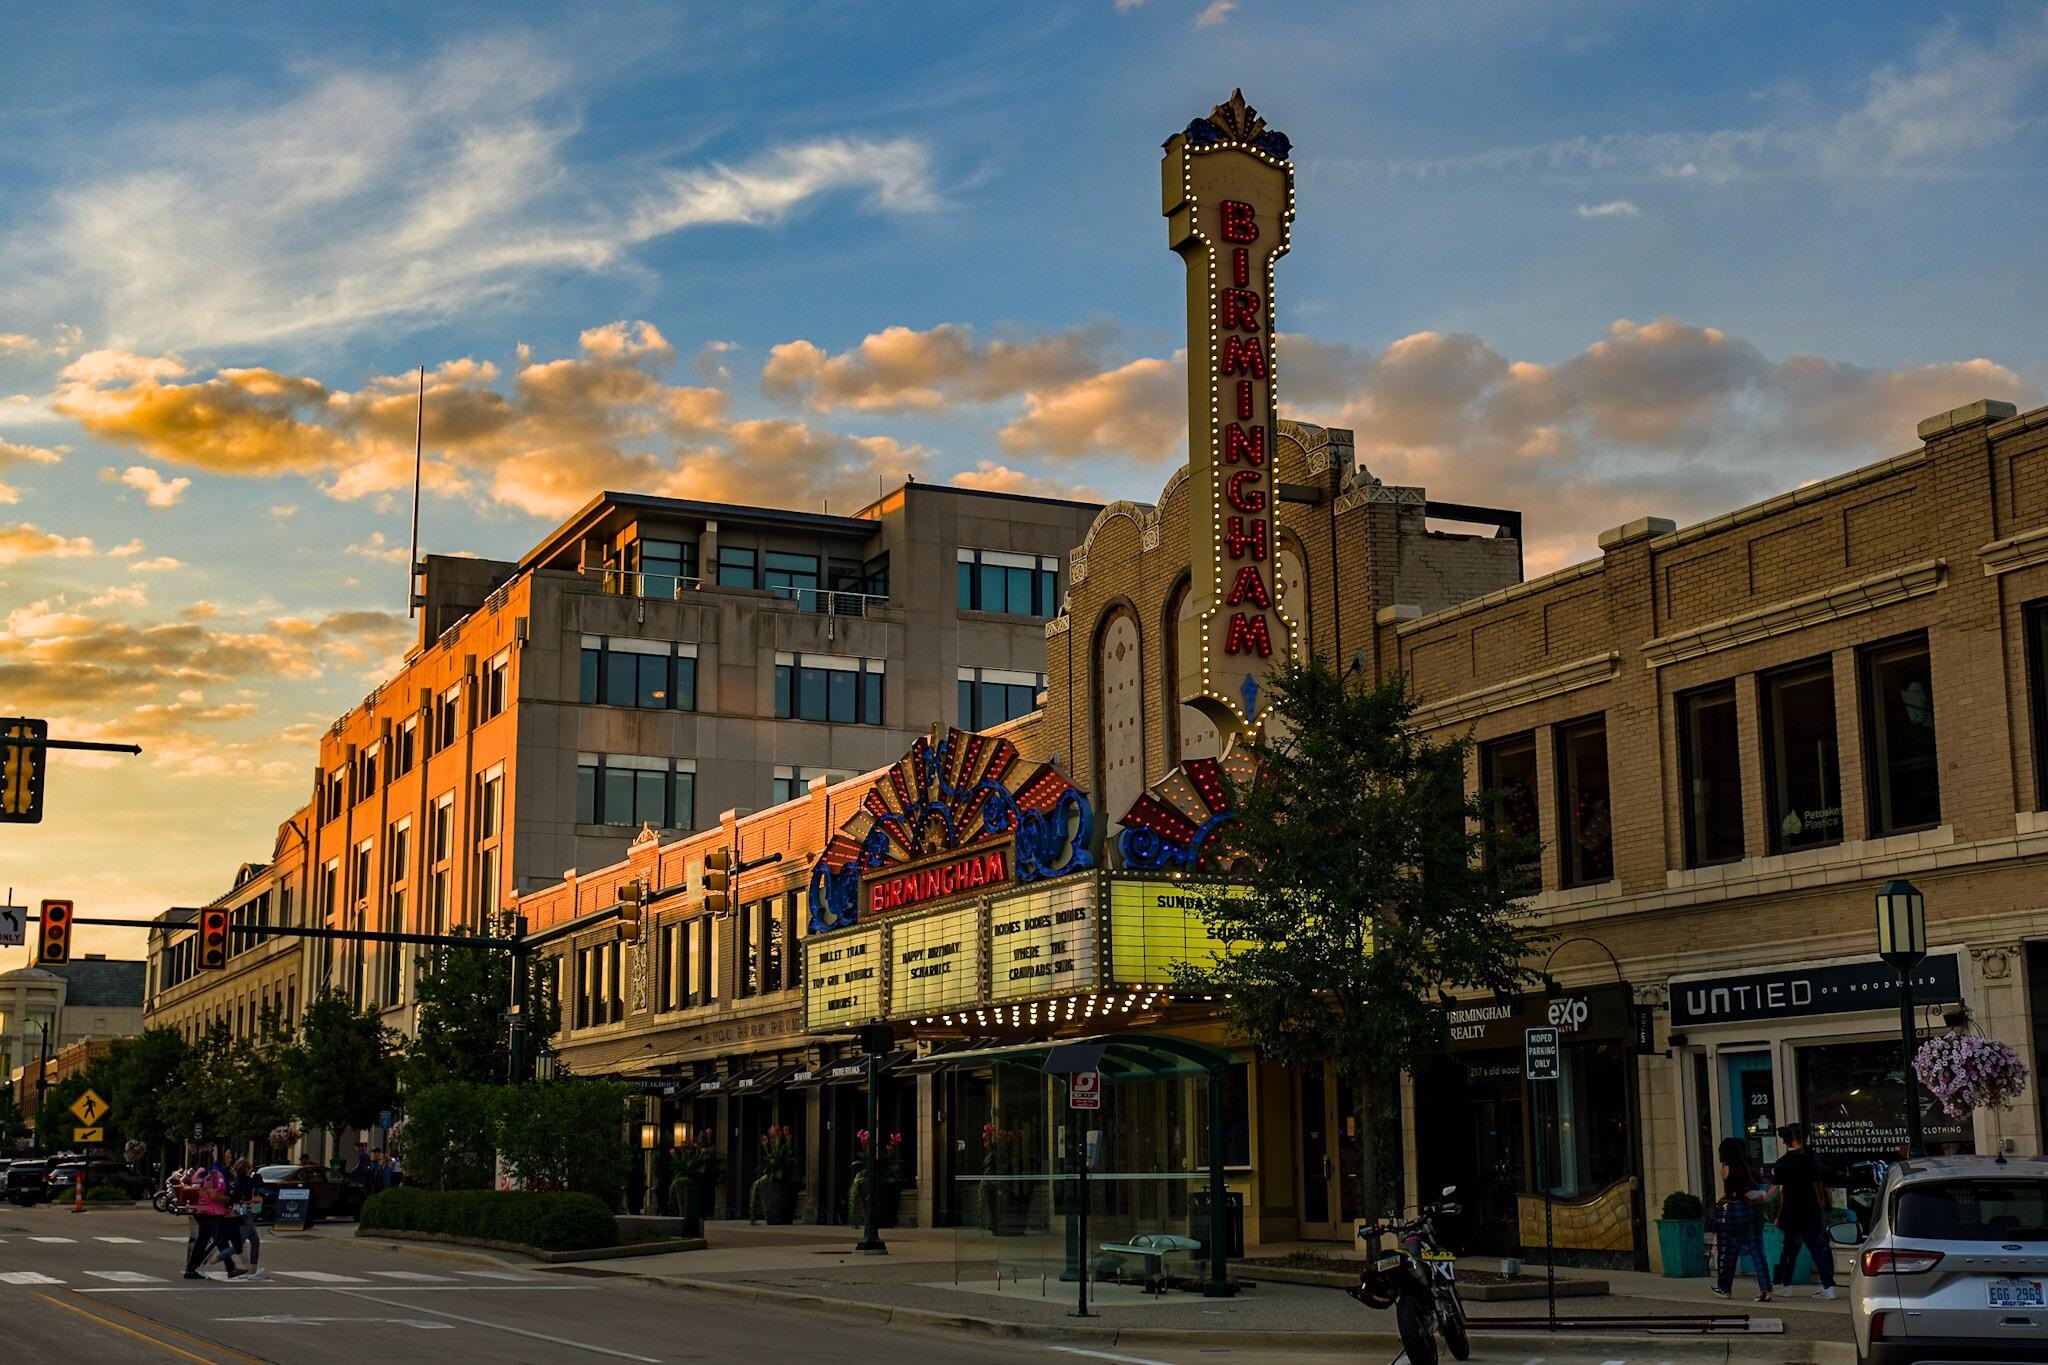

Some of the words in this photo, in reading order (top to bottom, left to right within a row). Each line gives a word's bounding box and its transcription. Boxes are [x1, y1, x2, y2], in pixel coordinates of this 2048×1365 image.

[1220, 199, 1272, 659] BIRMINGHAM
[1804, 806, 1841, 820] Petoske
[872, 850, 1007, 912] BIRMINGHAM
[1056, 907, 1085, 924] BODIES
[902, 949, 924, 964] HAPPY
[928, 942, 960, 958] BIRTHDAY
[1014, 946, 1039, 960] WHERE
[1050, 940, 1066, 954] THE
[1009, 963, 1051, 980] CRAWDADS
[1055, 959, 1074, 974] SING
[813, 978, 824, 988] TOP
[854, 995, 857, 1005] 2
[1450, 1005, 1511, 1024] BIRMINGHAM
[1548, 997, 1588, 1031] exp
[1450, 1025, 1485, 1040] REALTY
[1530, 1034, 1553, 1043] MOPED
[1529, 1046, 1556, 1055] PARKING
[1489, 1065, 1500, 1075] old
[1534, 1059, 1550, 1068] ONLY
[1751, 1094, 1768, 1105] 223
[1834, 1129, 1864, 1137] QUALITY
[1866, 1128, 1892, 1136] CASUAL
[1922, 1126, 1962, 1134] CLOTHING
[1836, 1120, 1874, 1129] CLOTHING
[1847, 1137, 1866, 1145] SIZES
[1884, 1136, 1910, 1144] EVERYO
[1991, 1287, 2010, 1301] EGG
[2016, 1287, 2042, 1301] 2969
